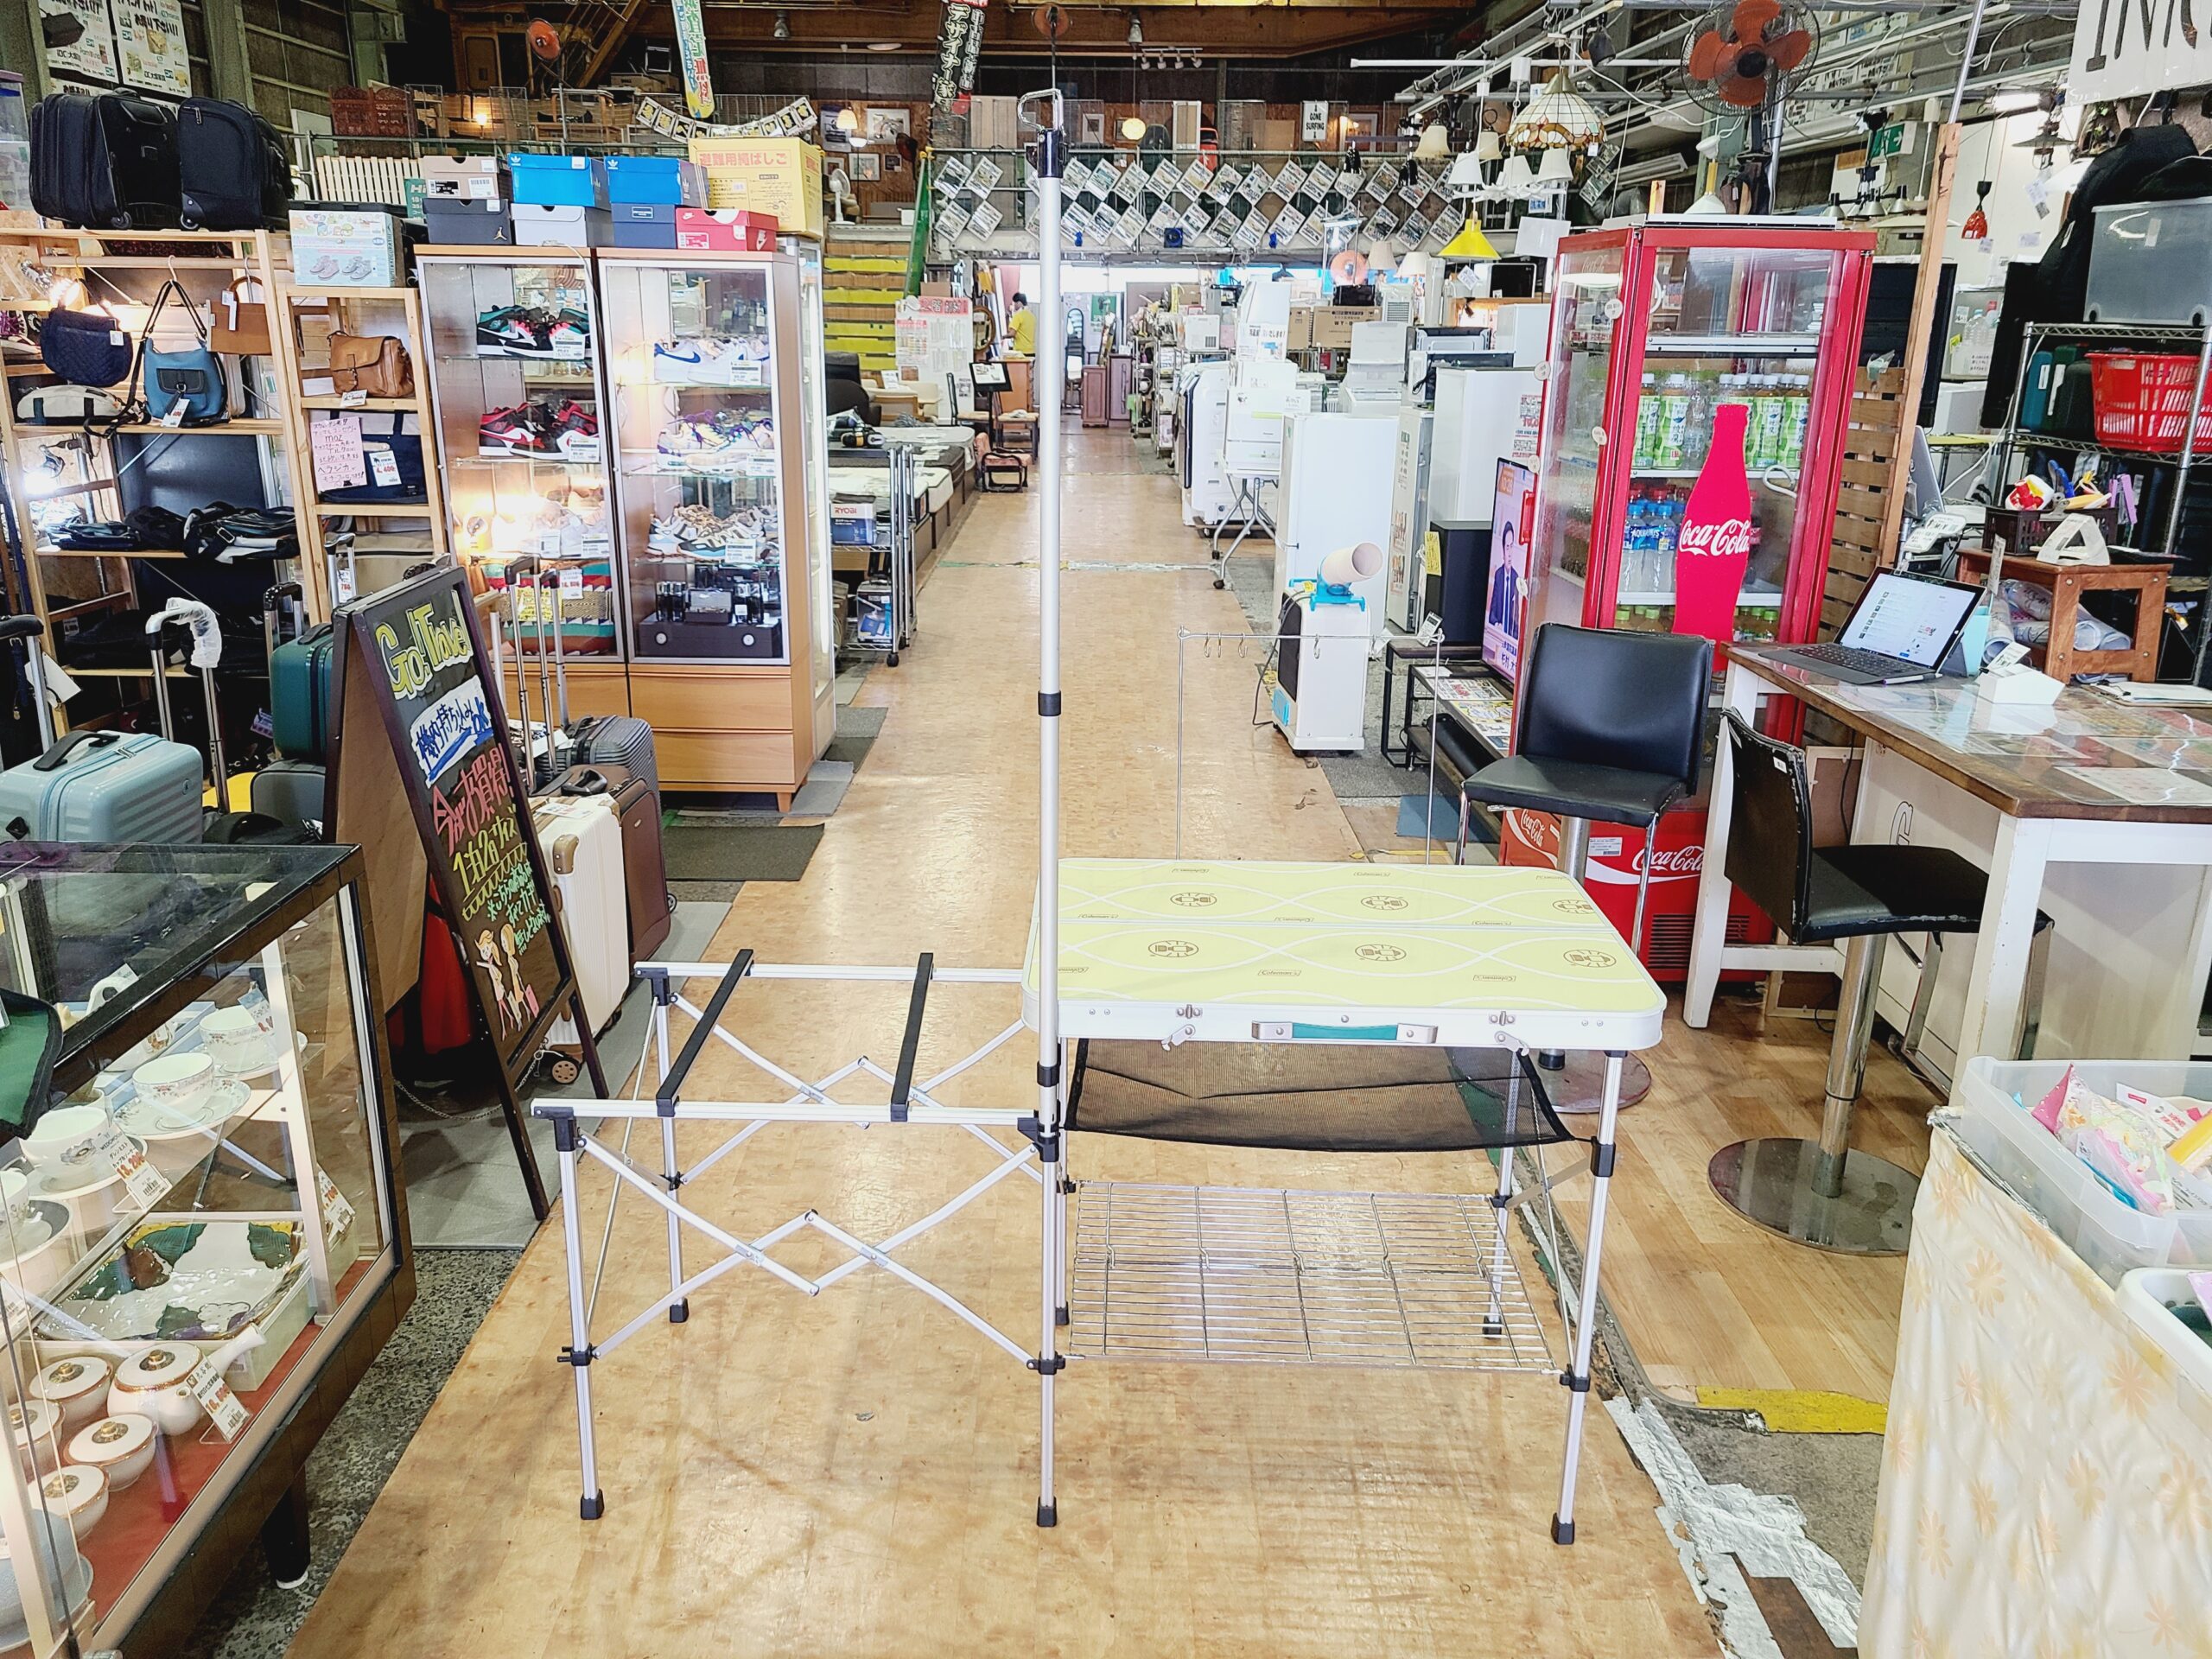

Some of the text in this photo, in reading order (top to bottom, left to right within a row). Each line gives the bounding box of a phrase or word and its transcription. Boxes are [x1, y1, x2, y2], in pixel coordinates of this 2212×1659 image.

[1309, 112, 1322, 121] GONE
[1306, 122, 1325, 130] SURFING
[834, 506, 857, 515] RYOBI
[1679, 518, 1751, 557] Coca-Cola
[1631, 845, 1707, 872] Cca-Col
